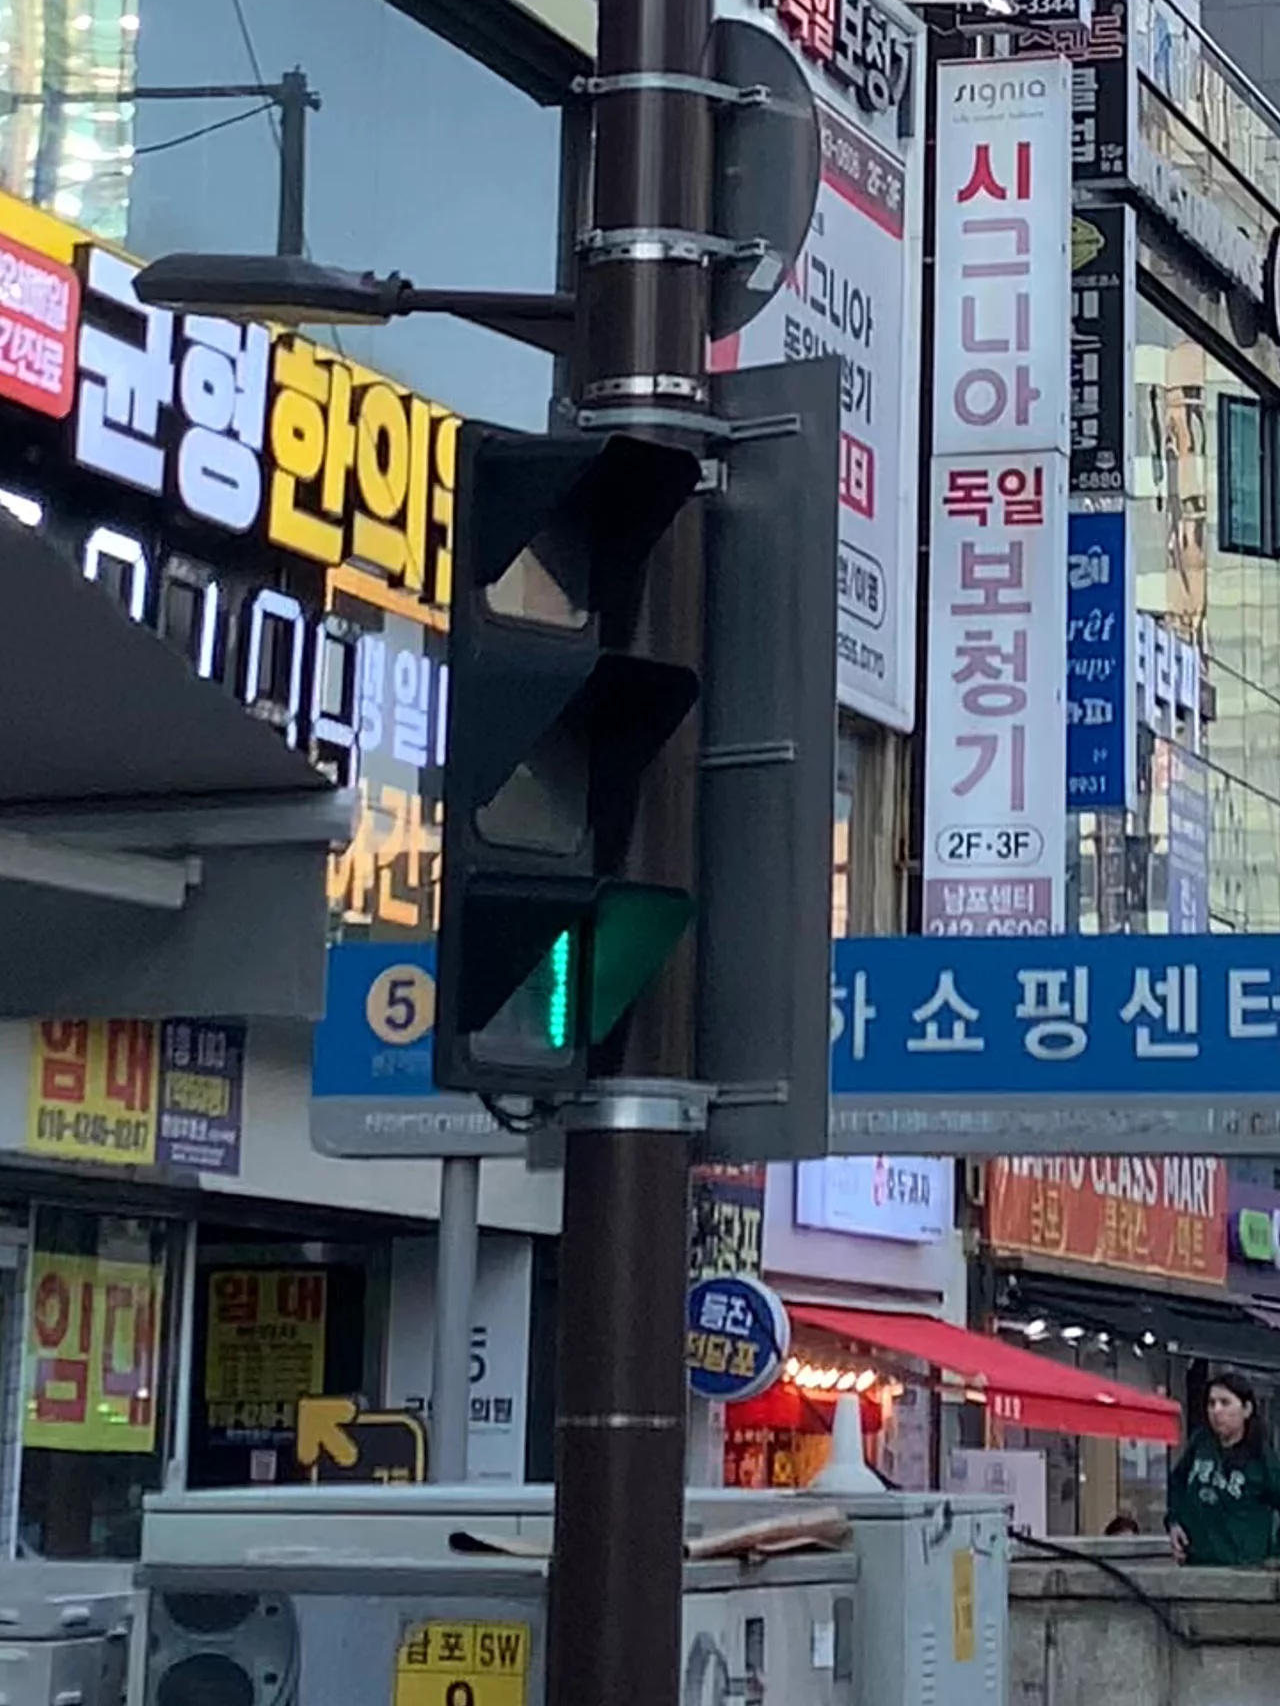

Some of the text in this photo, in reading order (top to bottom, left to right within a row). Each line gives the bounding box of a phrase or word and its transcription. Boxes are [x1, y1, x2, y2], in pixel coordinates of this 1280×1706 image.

[953, 79, 1047, 109] signia
[953, 139, 1042, 434] 시그니아
[942, 466, 1045, 528] 독일
[950, 540, 1033, 813] 보청기
[942, 882, 1035, 914] 남포센터
[384, 979, 417, 1031] 5
[1163, 1156, 1217, 1219] MART
[34, 1270, 154, 1426] 임대
[479, 1630, 522, 1669] SW
